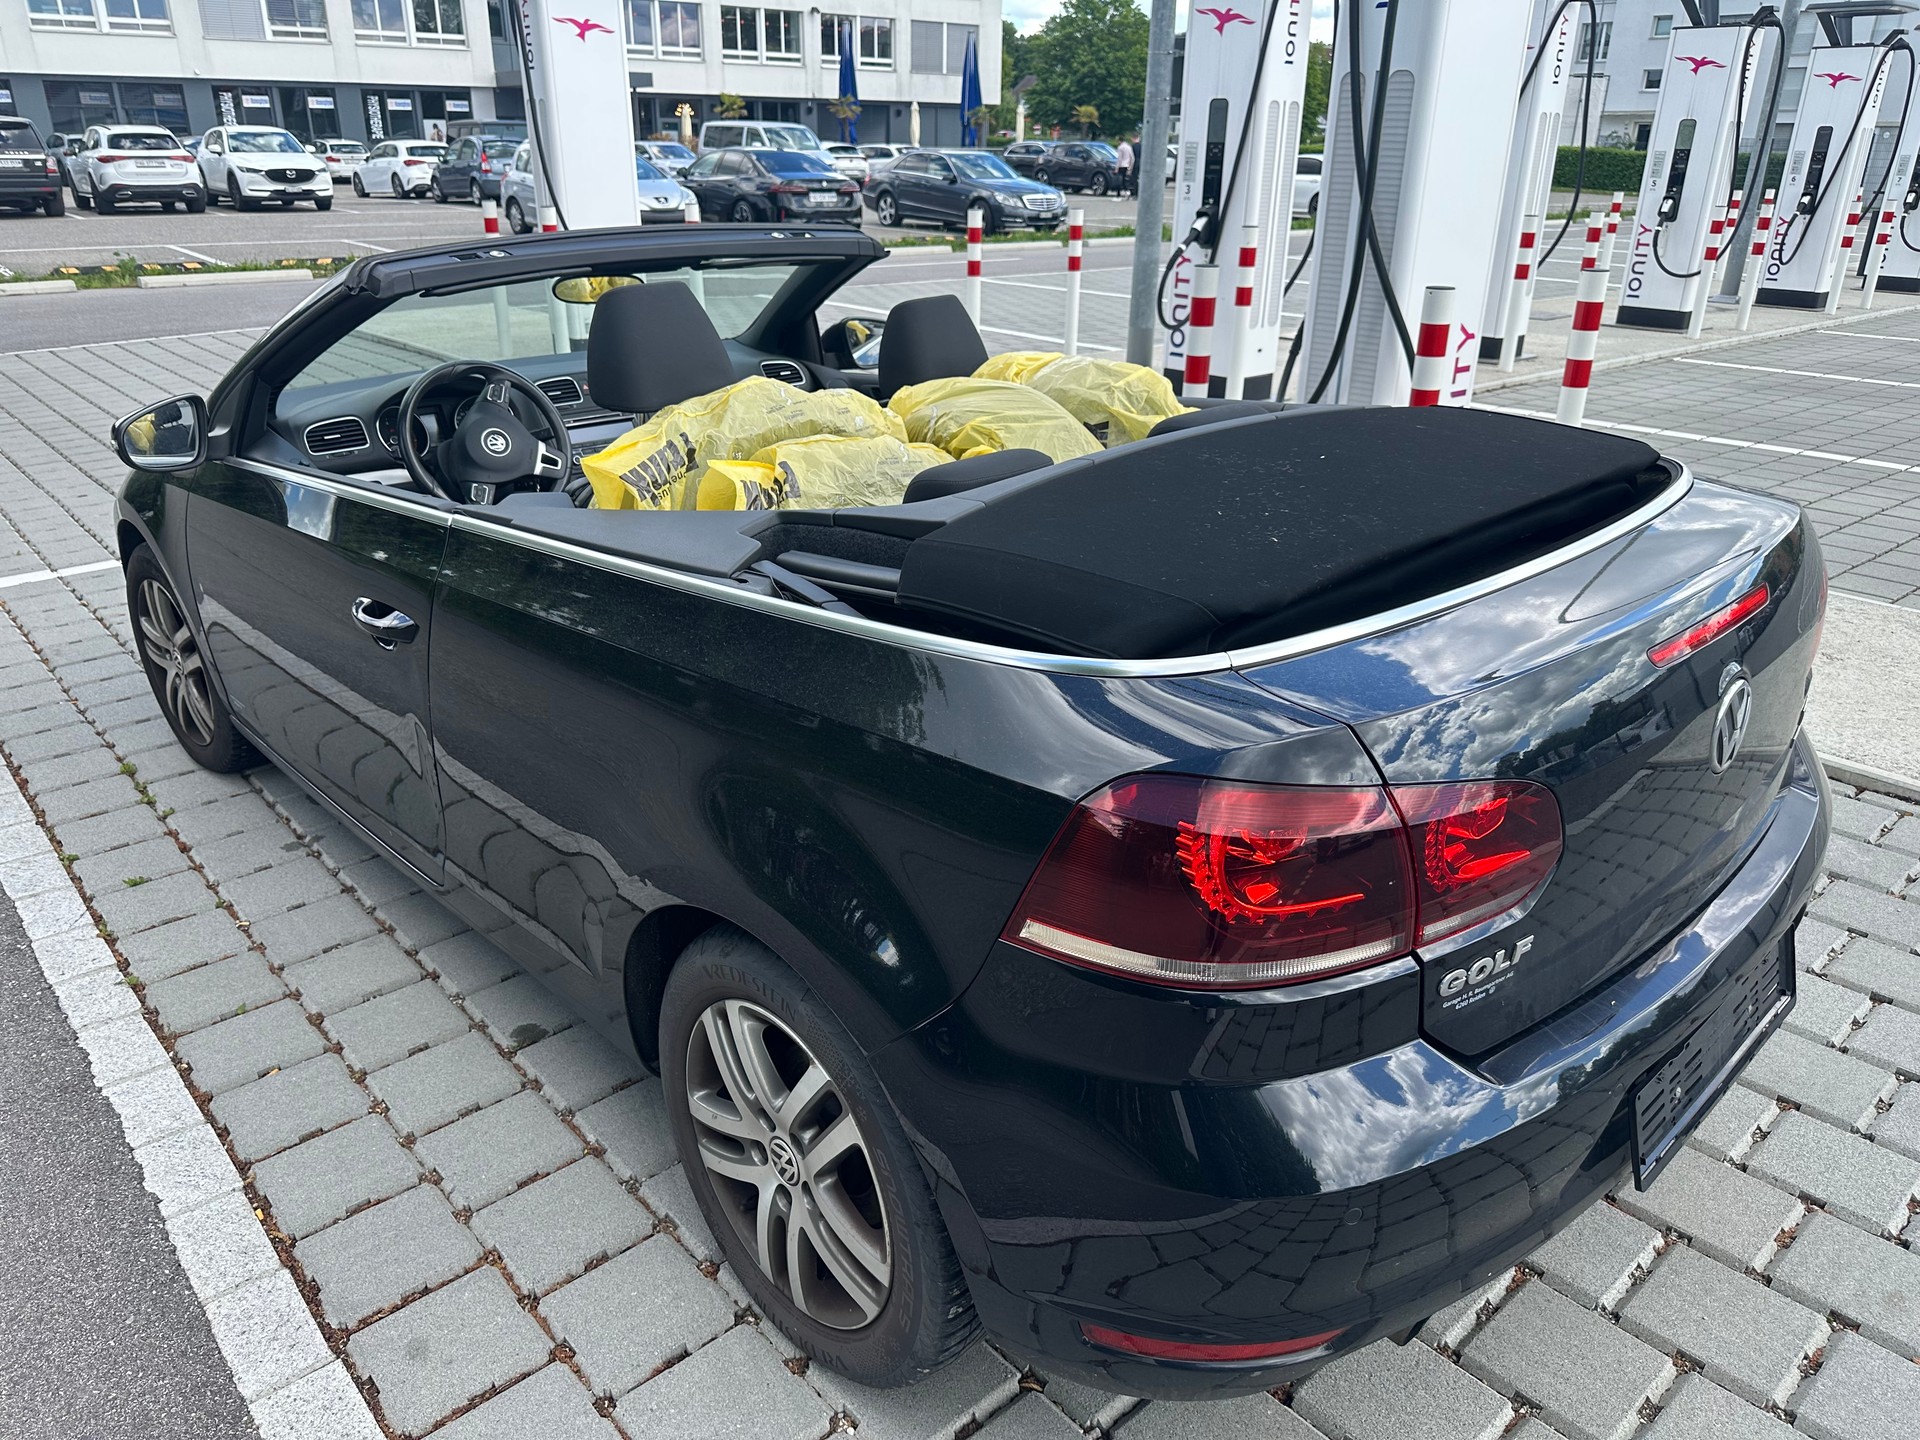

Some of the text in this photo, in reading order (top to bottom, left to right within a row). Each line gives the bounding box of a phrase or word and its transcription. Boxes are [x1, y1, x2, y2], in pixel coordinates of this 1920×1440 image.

[1284, 0, 1300, 65] IONIT
[1552, 14, 1569, 85] IONITY
[1184, 184, 1192, 195] 3
[1650, 179, 1657, 188] 5
[1791, 175, 1797, 183] 6
[1626, 223, 1653, 299] IONITY
[1766, 216, 1790, 281] IONITY
[1169, 254, 1192, 358] IONITY
[1449, 323, 1476, 398] ITY
[1438, 933, 1535, 998] GOLF
[1505, 970, 1514, 979] AG
